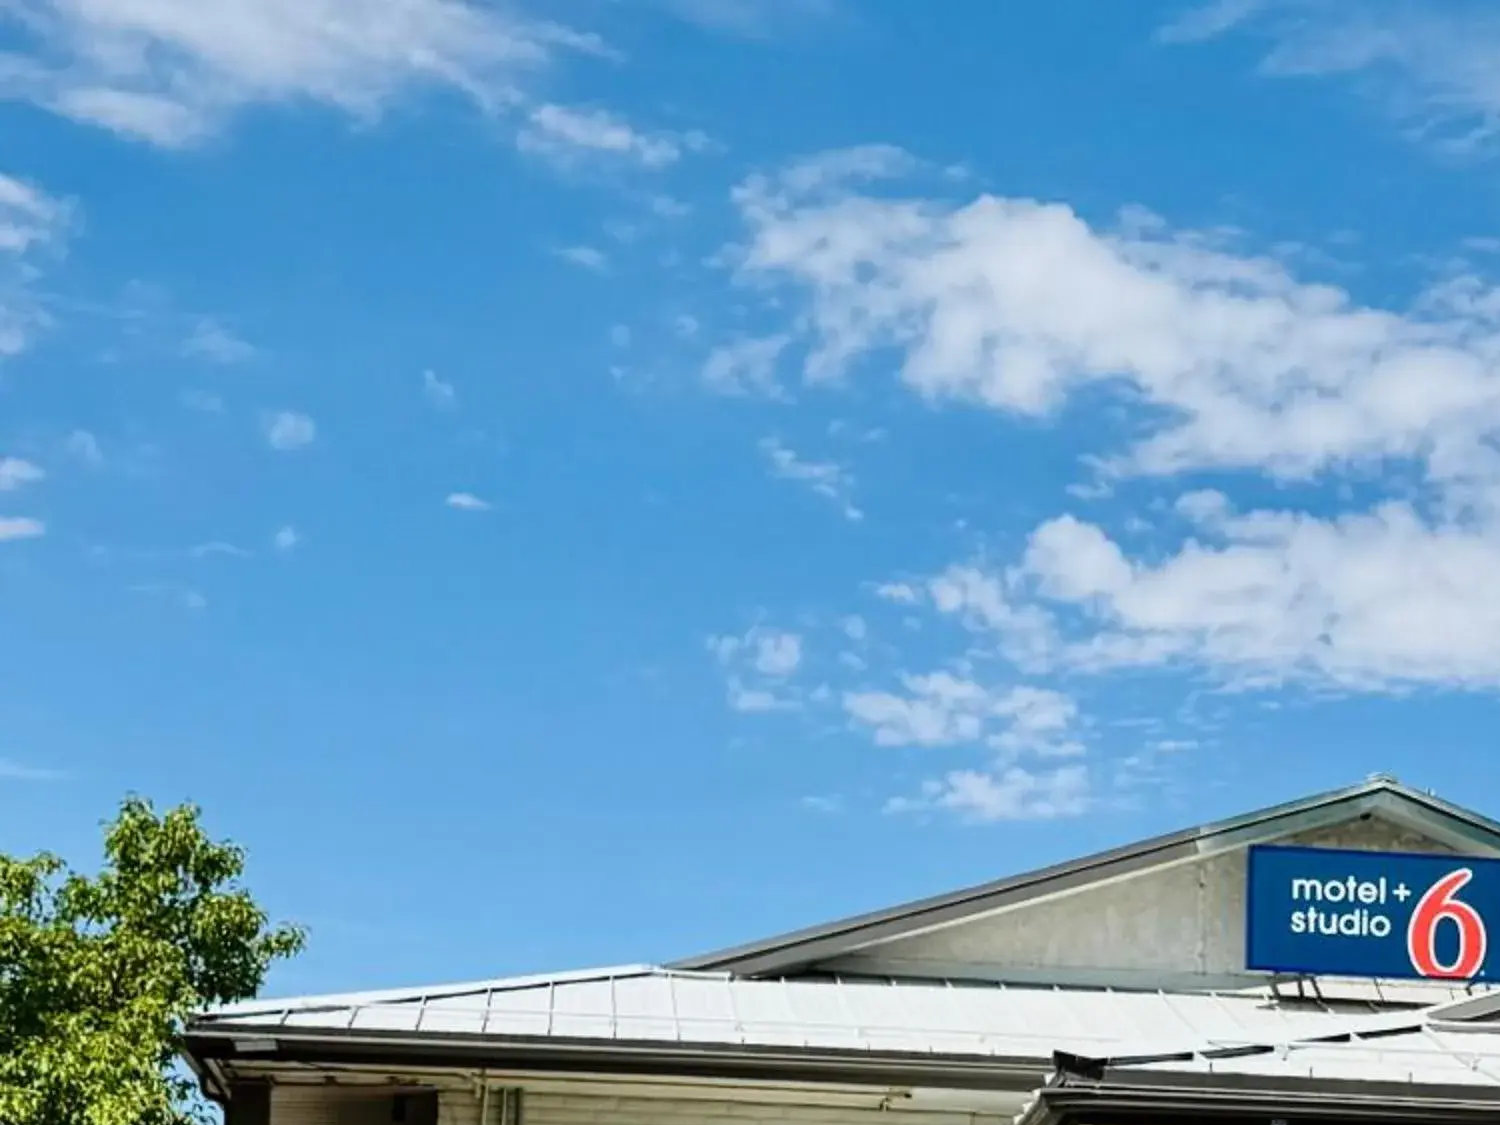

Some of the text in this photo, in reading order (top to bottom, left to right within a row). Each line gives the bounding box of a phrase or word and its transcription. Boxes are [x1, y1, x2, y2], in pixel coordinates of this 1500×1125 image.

[1292, 875, 1386, 904] motel
[1290, 907, 1391, 937] studio
[1407, 867, 1487, 979] 6
